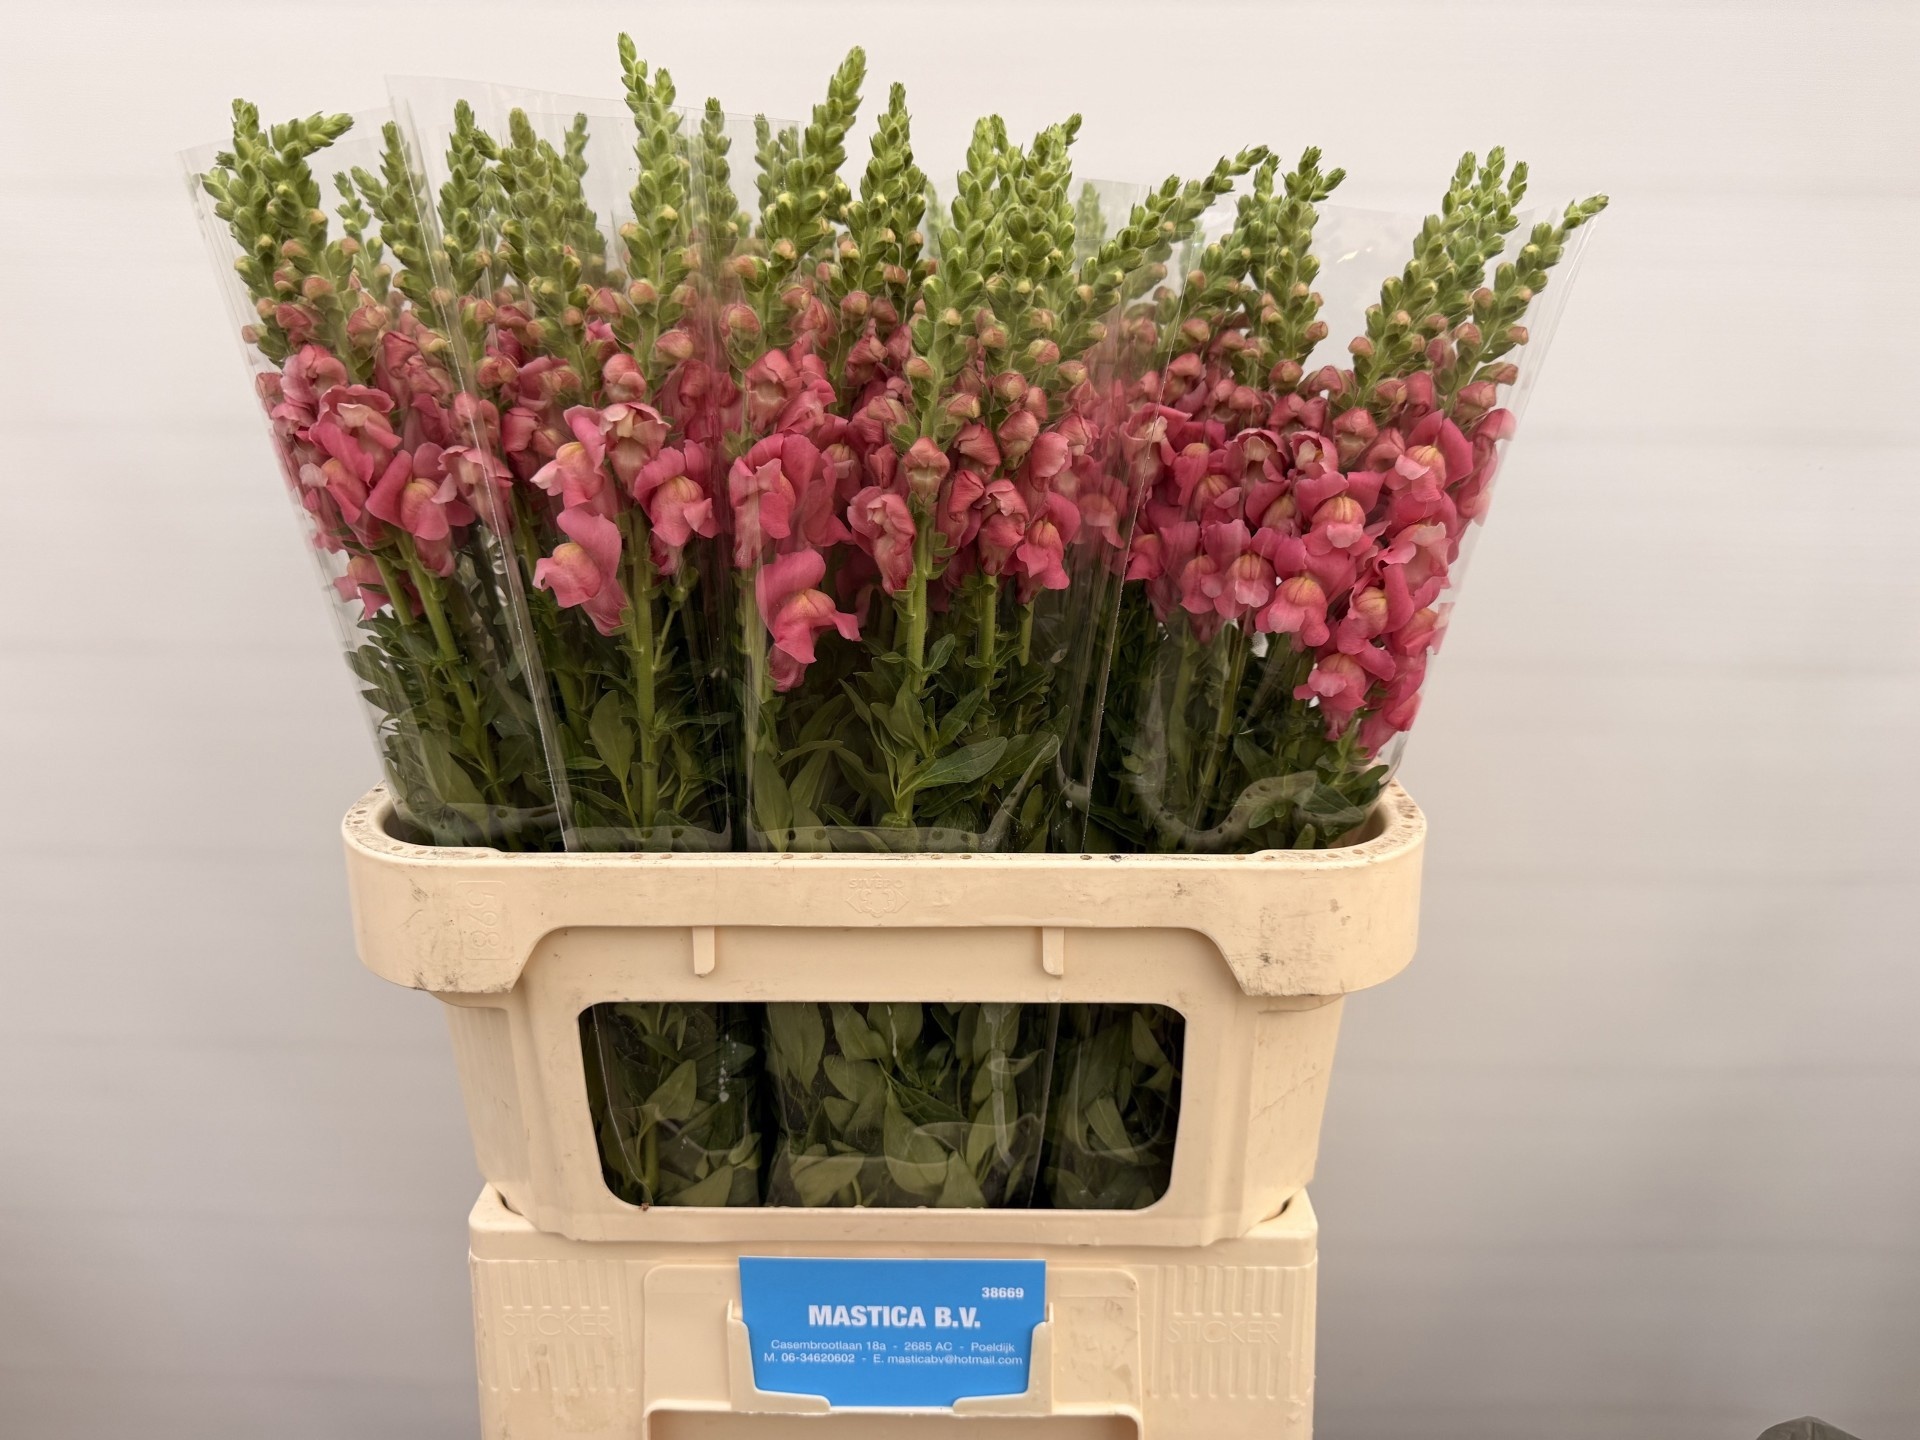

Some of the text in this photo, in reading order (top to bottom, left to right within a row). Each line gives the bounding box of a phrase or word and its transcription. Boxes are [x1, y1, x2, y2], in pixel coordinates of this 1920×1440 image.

[981, 1286, 1025, 1299] 38669
[501, 1312, 614, 1337] STICKER
[808, 1305, 981, 1329] MASTICA B.V.
[1167, 1320, 1281, 1345] STICKER
[770, 1339, 863, 1351] Casembrootlaan
[866, 1340, 887, 1351] 18a
[903, 1341, 933, 1352] 2685
[934, 1341, 953, 1352] AC
[970, 1341, 1016, 1355] Poeldijk
[764, 1352, 778, 1363] M.
[781, 1352, 855, 1364] 06-34620602
[873, 1353, 885, 1364] E.
[887, 1353, 1023, 1365] masticabv@hotmail.com
